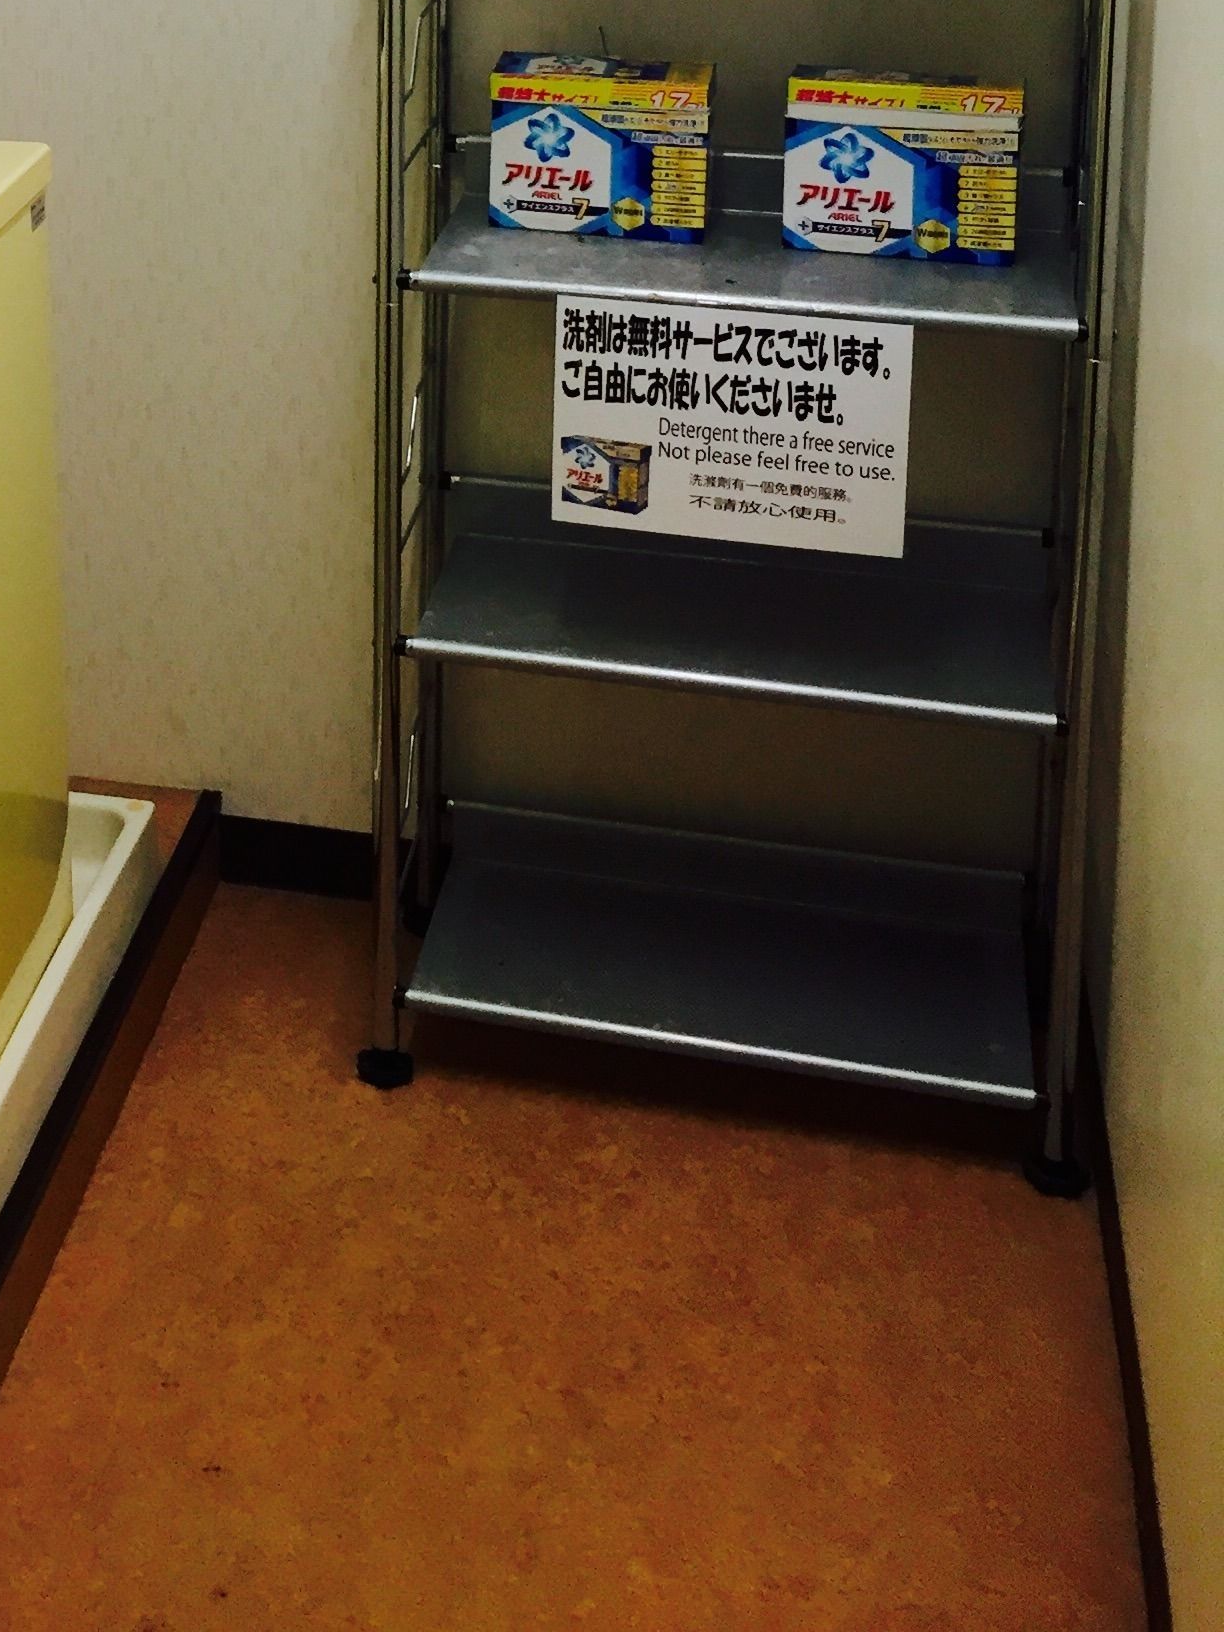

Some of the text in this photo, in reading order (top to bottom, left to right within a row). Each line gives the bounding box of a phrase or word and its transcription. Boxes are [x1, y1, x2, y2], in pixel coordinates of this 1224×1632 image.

[502, 163, 592, 192] アリエール
[520, 197, 591, 220] サイエンスプラス 7
[531, 190, 563, 200] ARIEL
[796, 184, 895, 213] アリエール
[817, 220, 891, 242] サイエンスプラス 7
[828, 212, 862, 223] ARIEL
[562, 308, 891, 380] 洗剤は無料サービスでございます。
[561, 359, 844, 426] ご自由にお使いくださいませ。
[659, 417, 895, 459] Detergent there a free service
[566, 468, 604, 484] アリエール
[658, 441, 896, 482] Not please feel free to use.
[689, 494, 847, 525] 不請放心使用。
